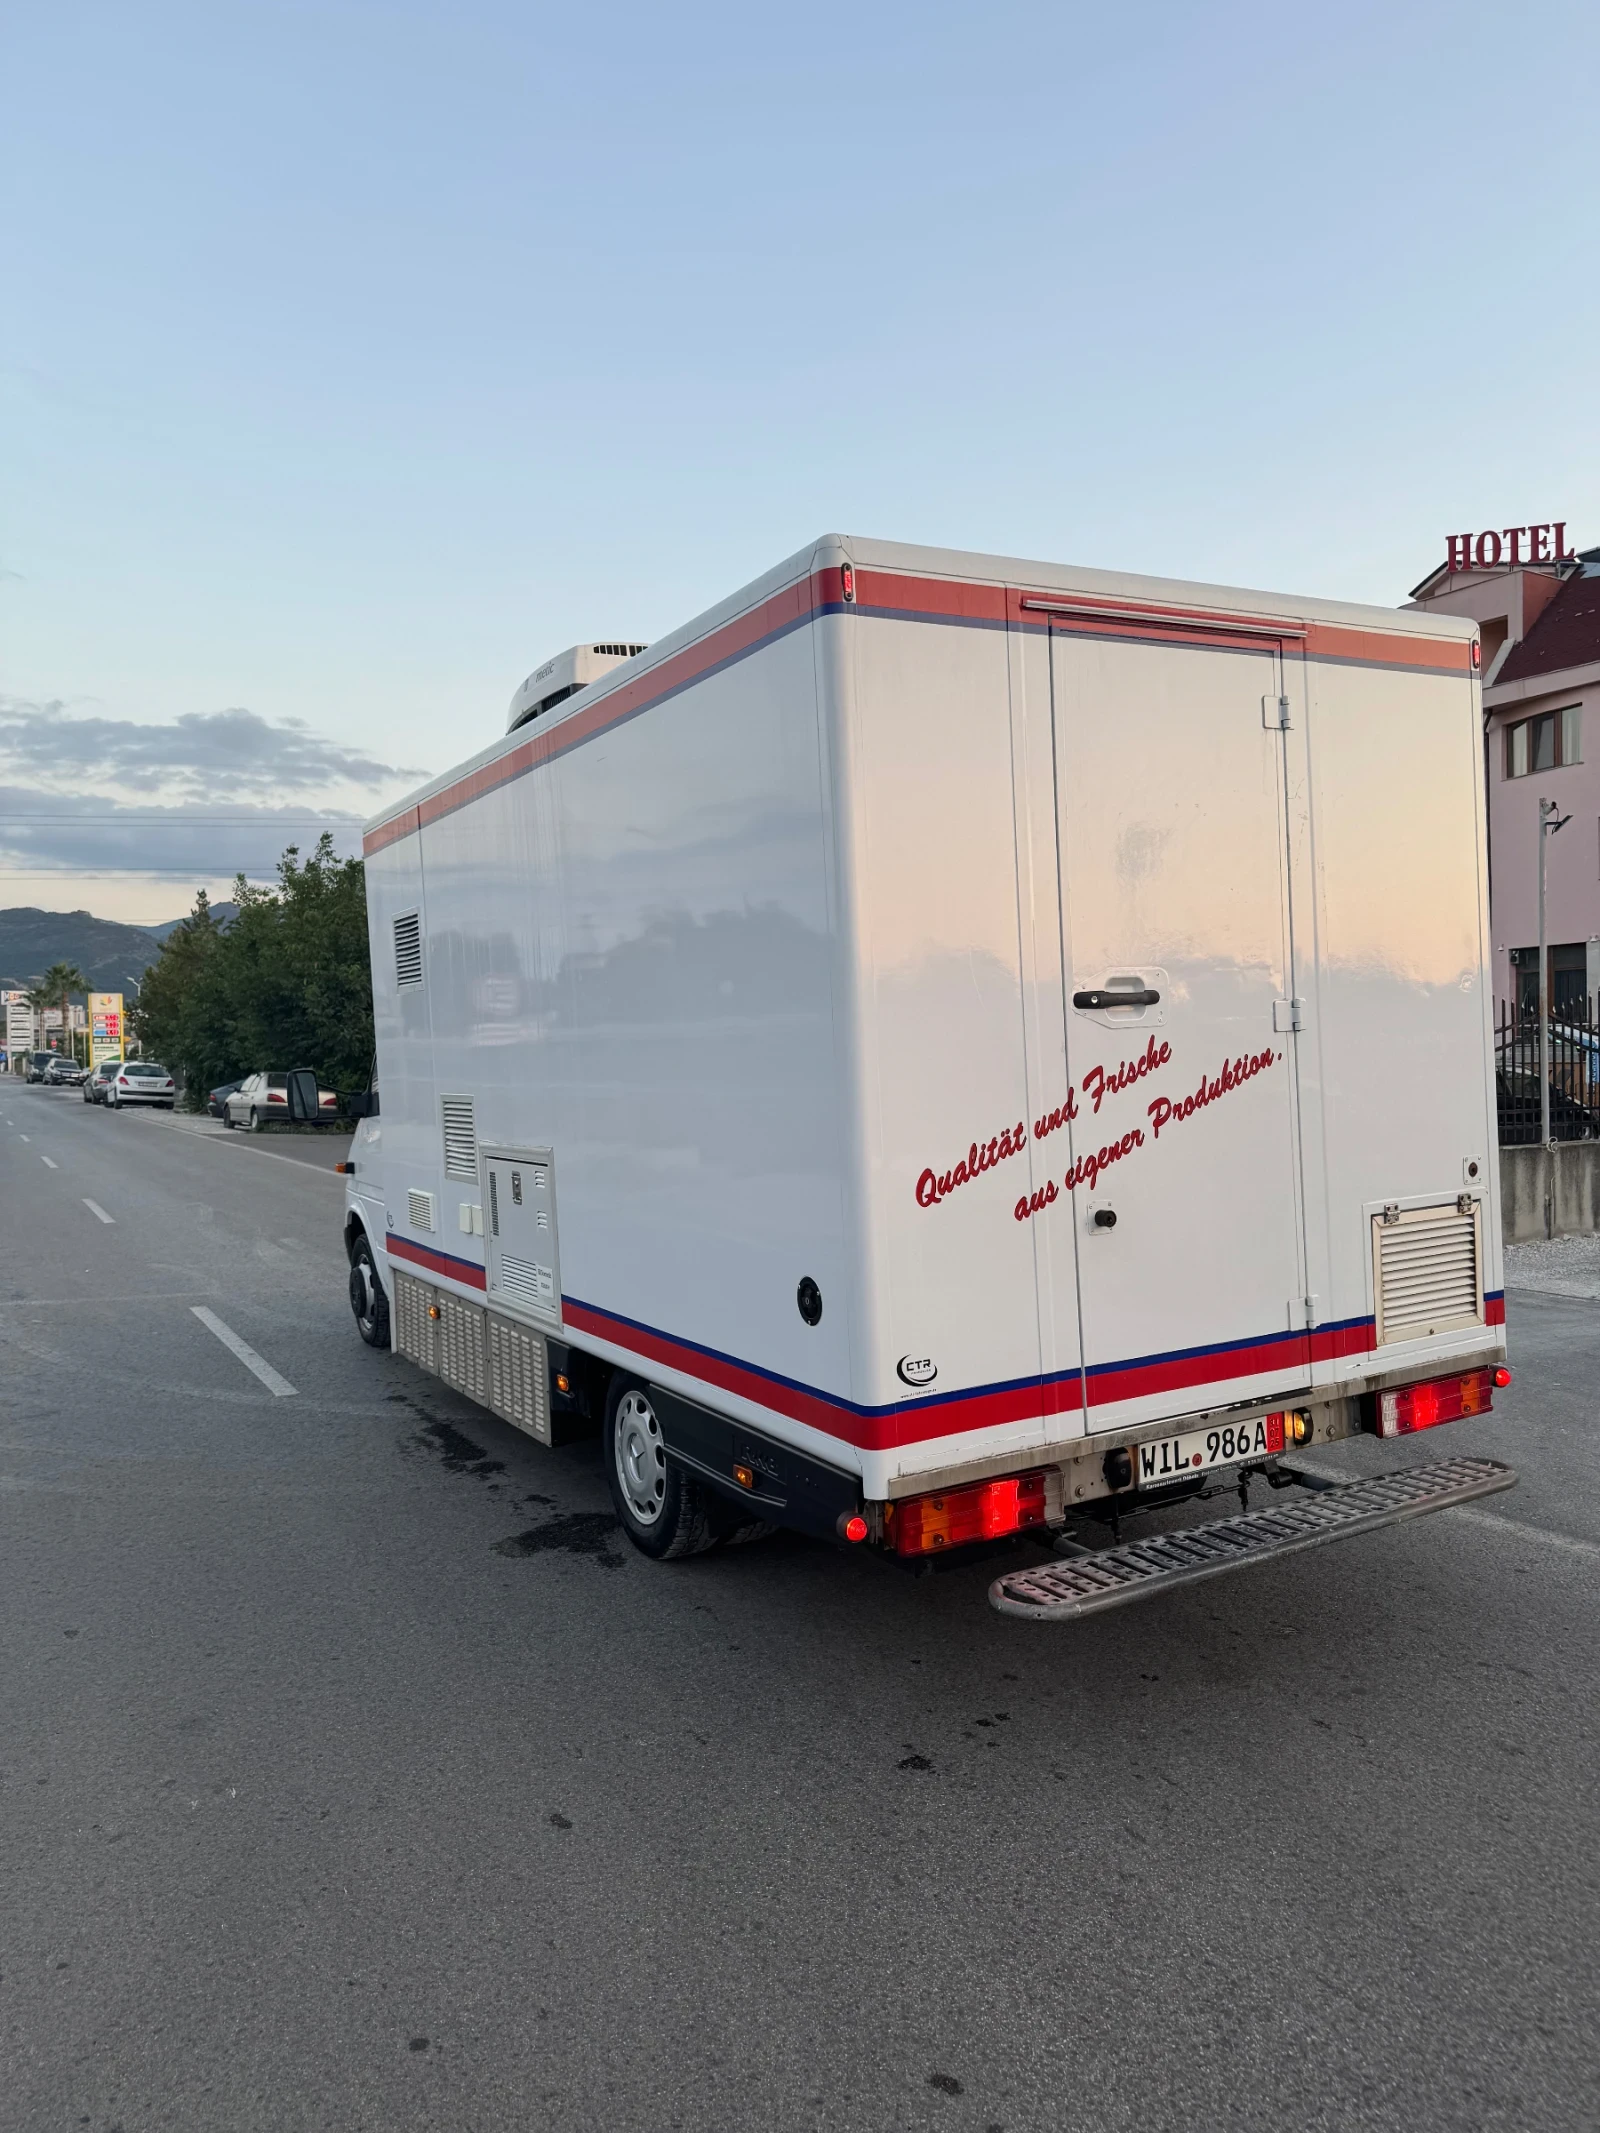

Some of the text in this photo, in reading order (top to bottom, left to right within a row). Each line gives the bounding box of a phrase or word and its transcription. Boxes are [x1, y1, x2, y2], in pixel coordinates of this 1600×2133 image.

[1445, 522, 1575, 573] HOTEL
[915, 1034, 1172, 1208] Qualität und Frische
[1013, 1047, 1282, 1222] aus eigener Produktion.
[906, 1358, 931, 1372] CTR
[1140, 1440, 1190, 1478] WIL
[1206, 1421, 1268, 1462] 986A
[1269, 1426, 1280, 1438] 07
[1269, 1436, 1280, 1448] 25
